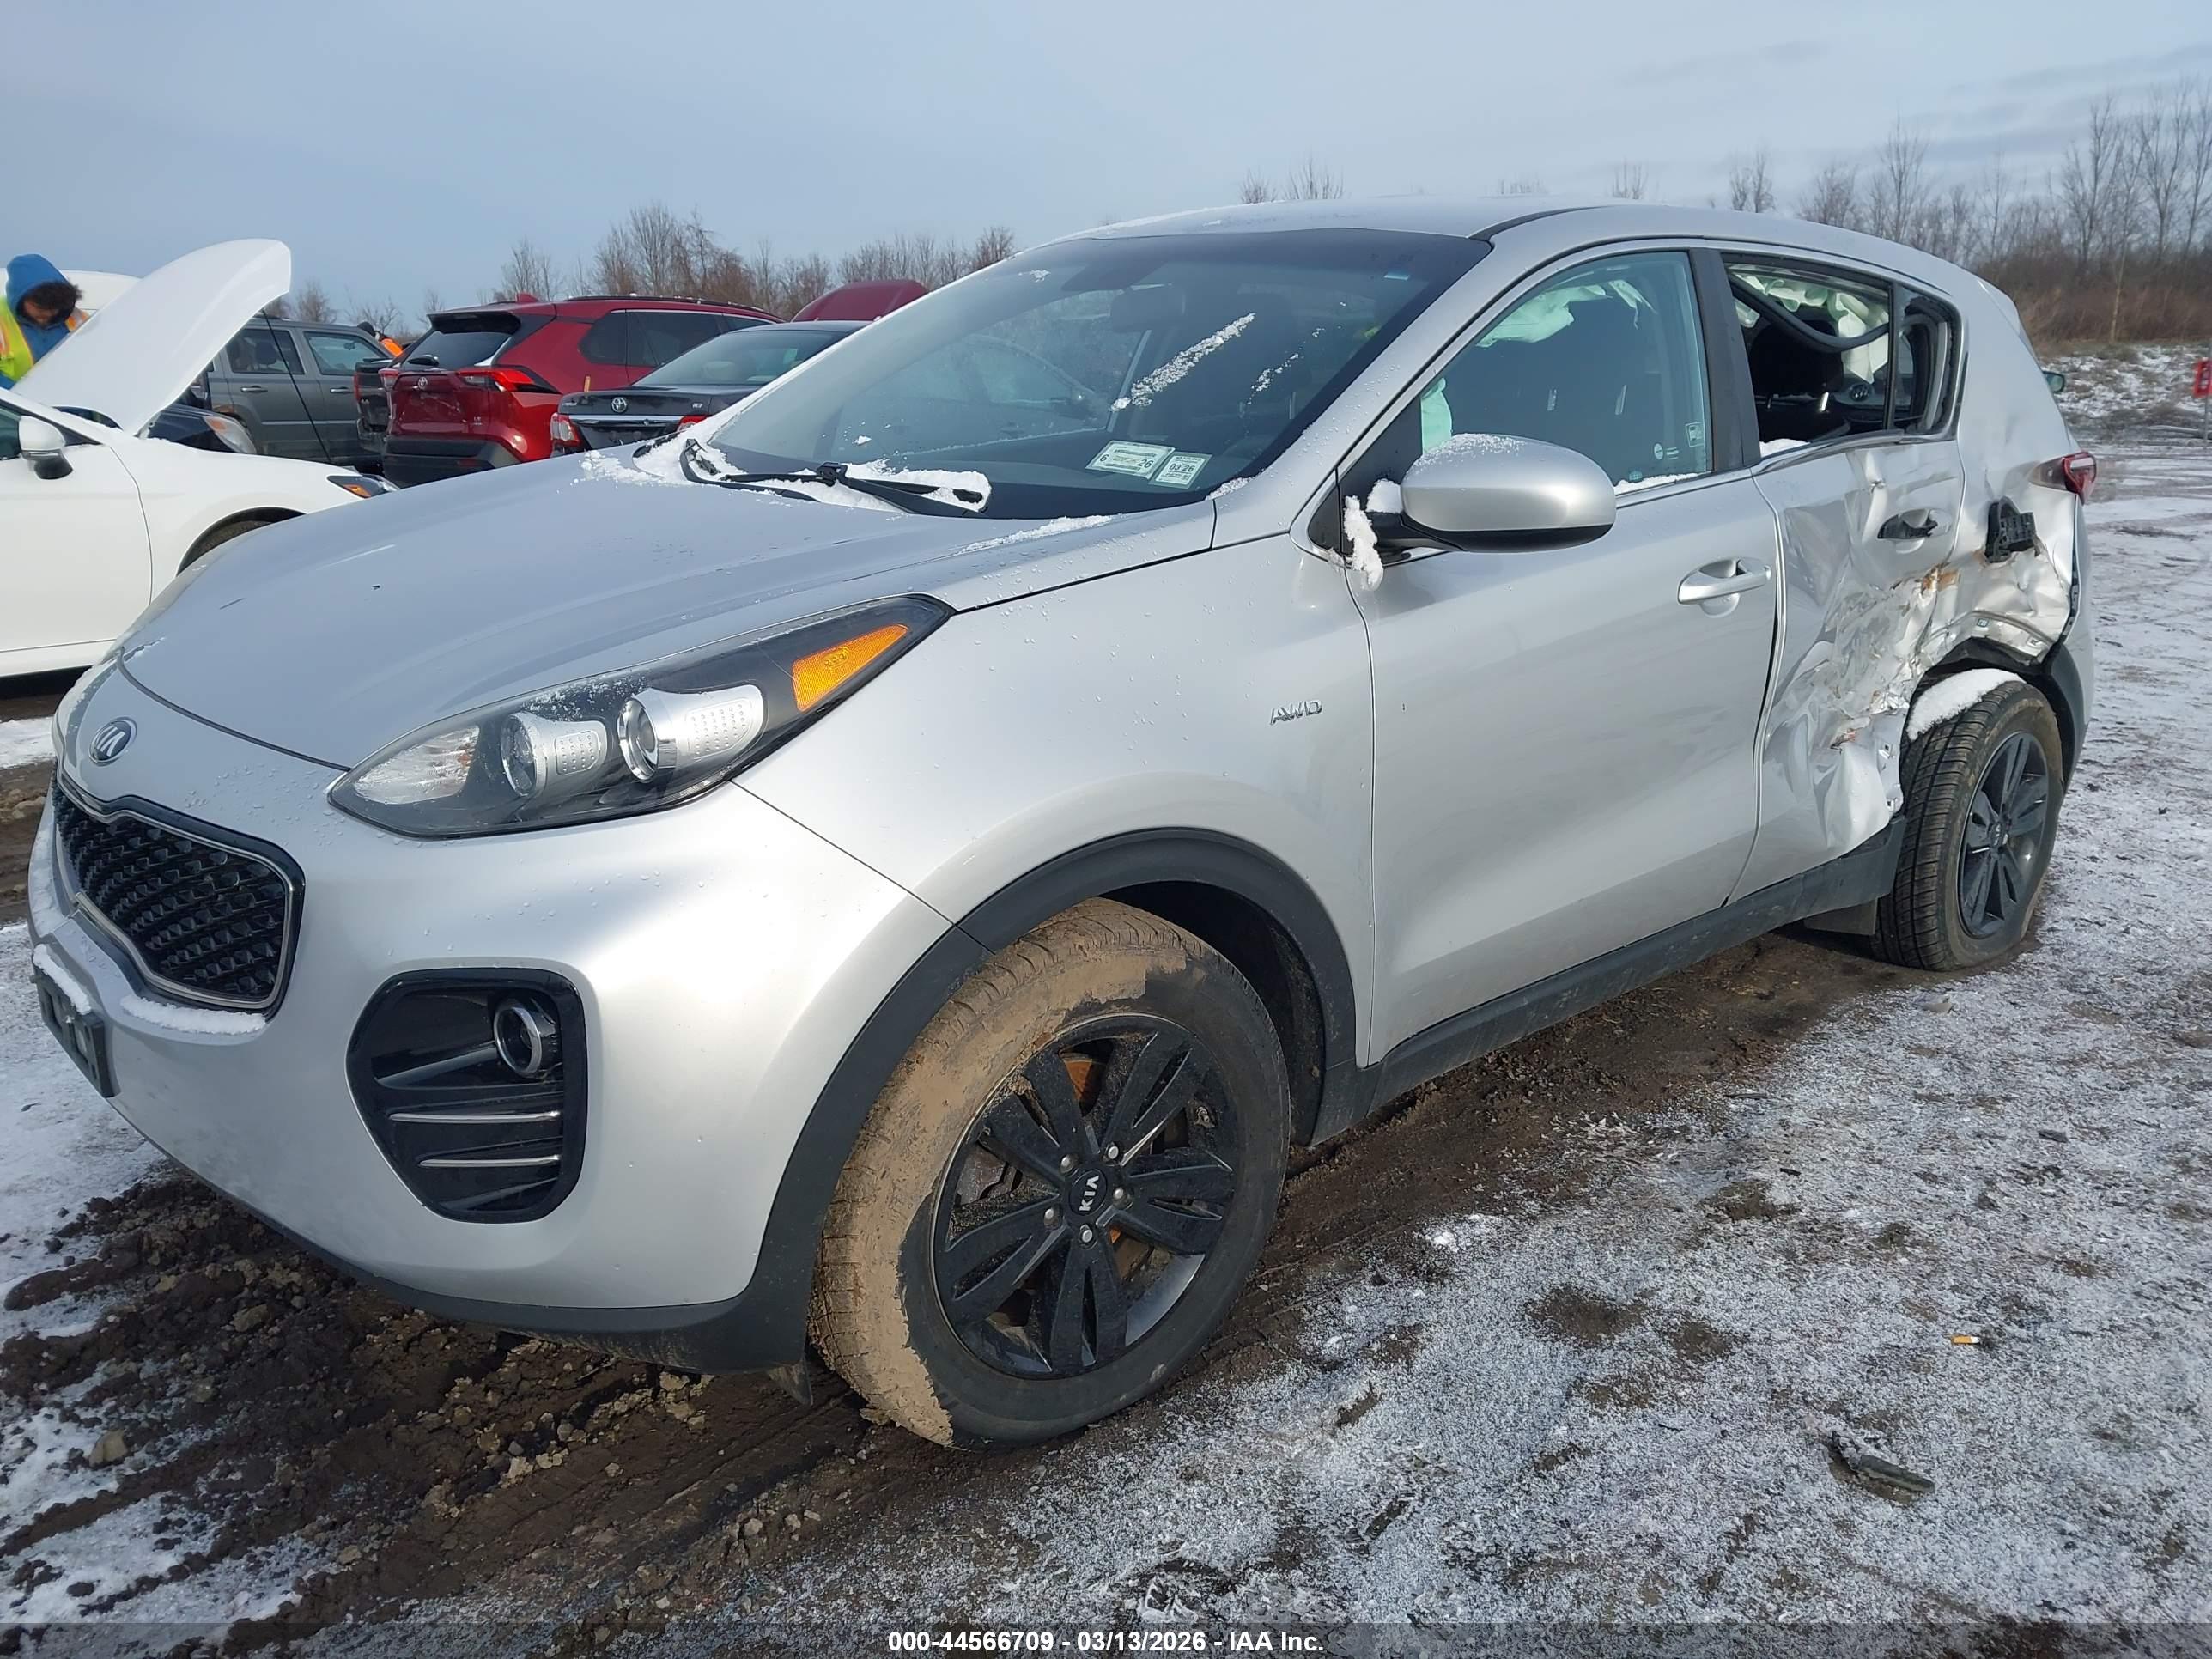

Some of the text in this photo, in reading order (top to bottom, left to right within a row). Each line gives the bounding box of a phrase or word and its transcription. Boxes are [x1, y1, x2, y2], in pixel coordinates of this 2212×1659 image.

[1100, 453, 1109, 462] 6
[1137, 459, 1154, 469] 26
[1270, 701, 1322, 726] AWD
[1078, 1175, 1100, 1212] KIA
